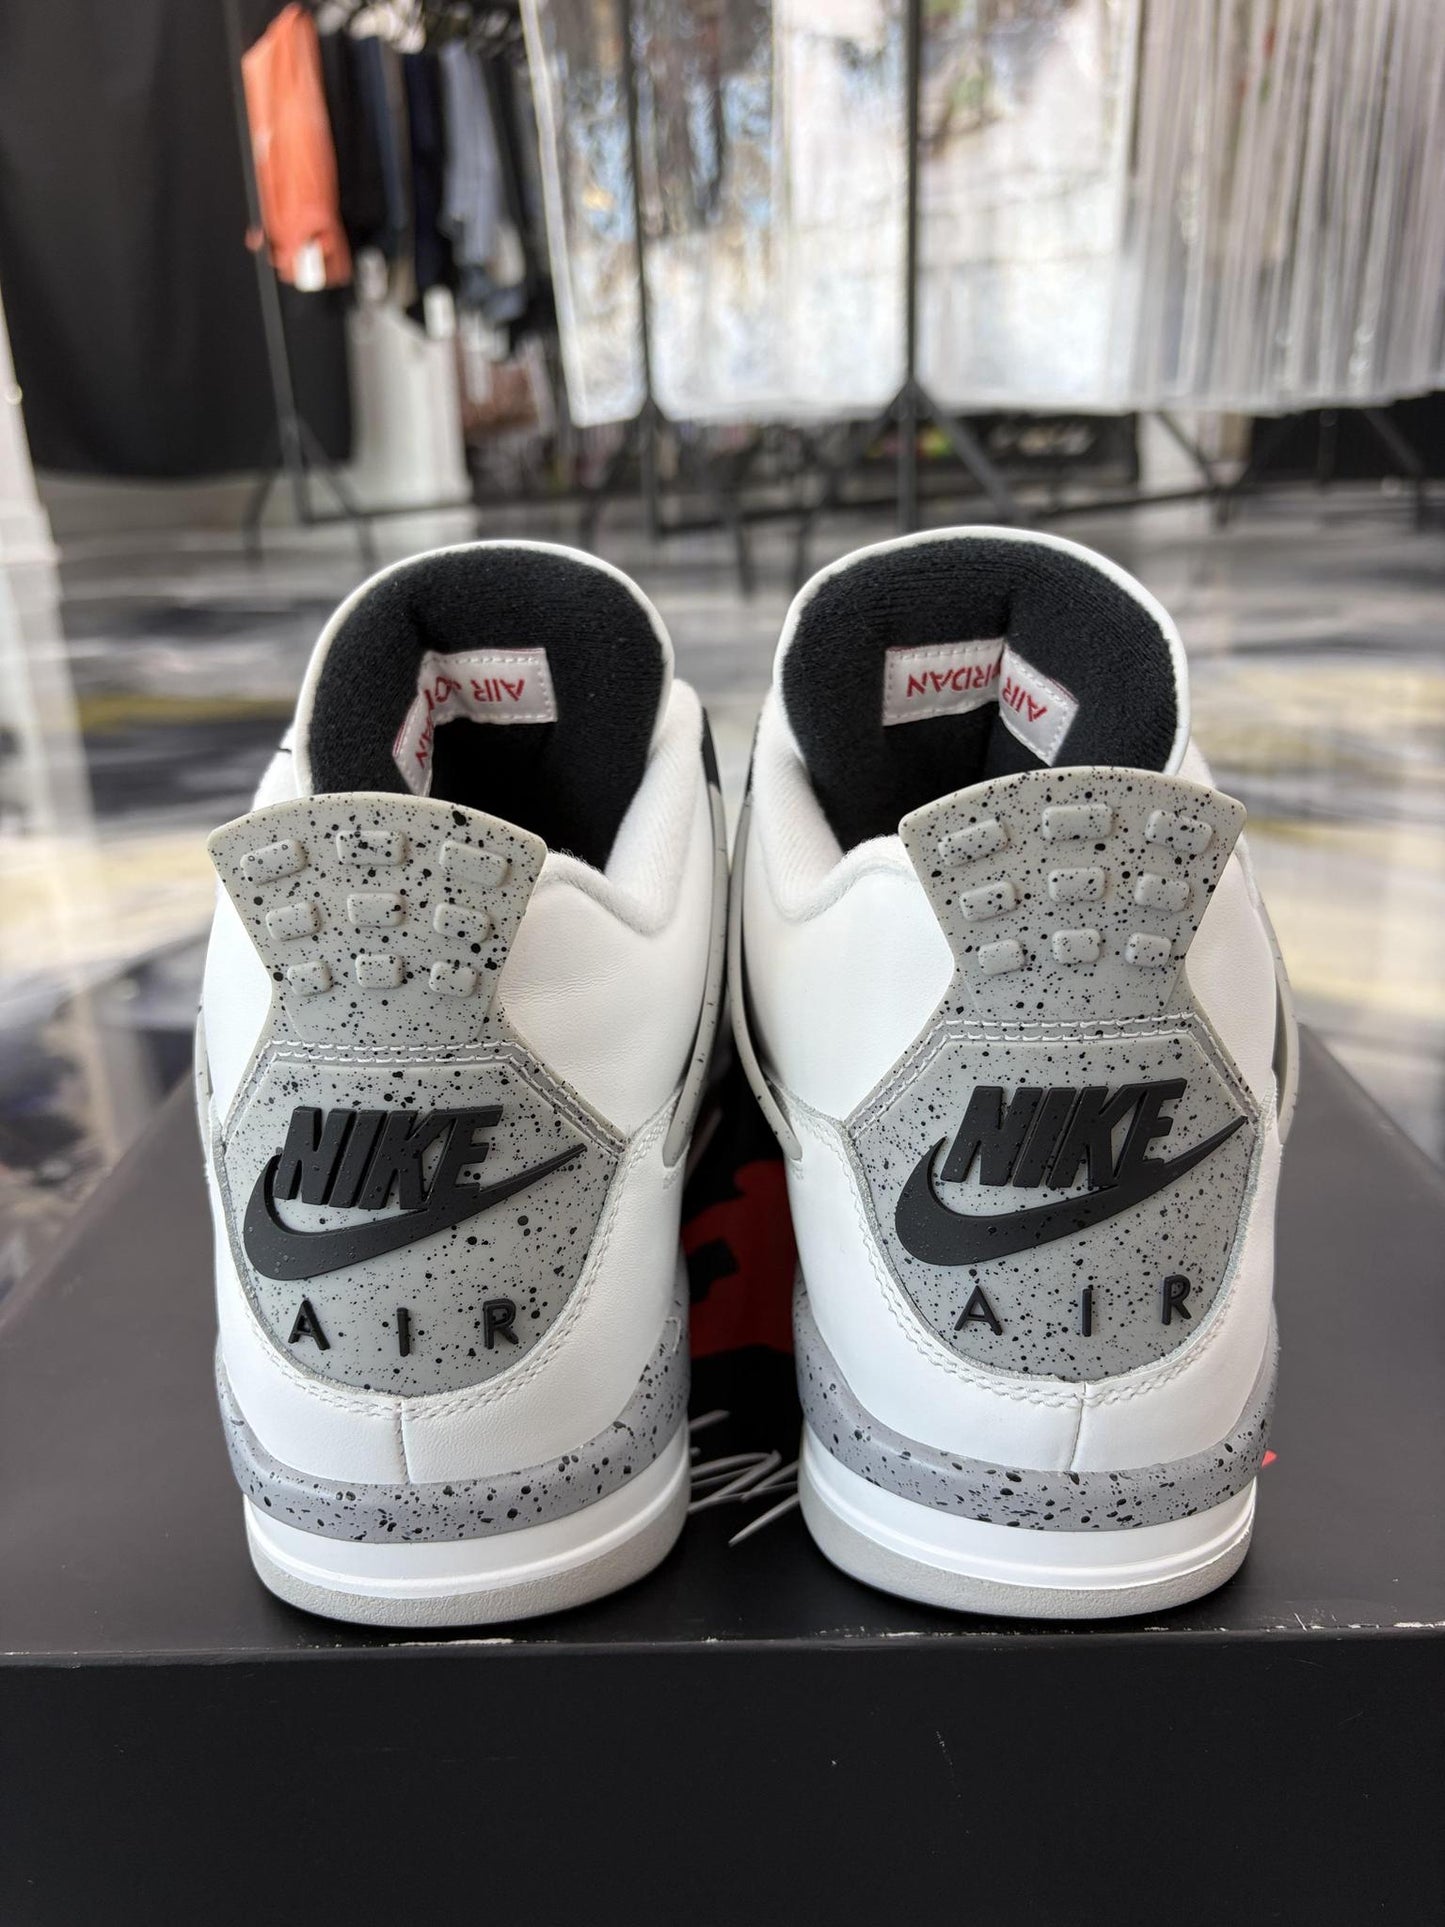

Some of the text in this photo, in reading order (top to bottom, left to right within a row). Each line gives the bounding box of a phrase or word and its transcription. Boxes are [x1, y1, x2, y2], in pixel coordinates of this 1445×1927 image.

[470, 678, 525, 703] AIR
[1001, 676, 1048, 723] AIR
[272, 1104, 504, 1211] NIKE
[940, 1077, 1188, 1189] NIKE
[287, 1298, 520, 1358] AIR
[953, 1274, 1192, 1338] AIR
